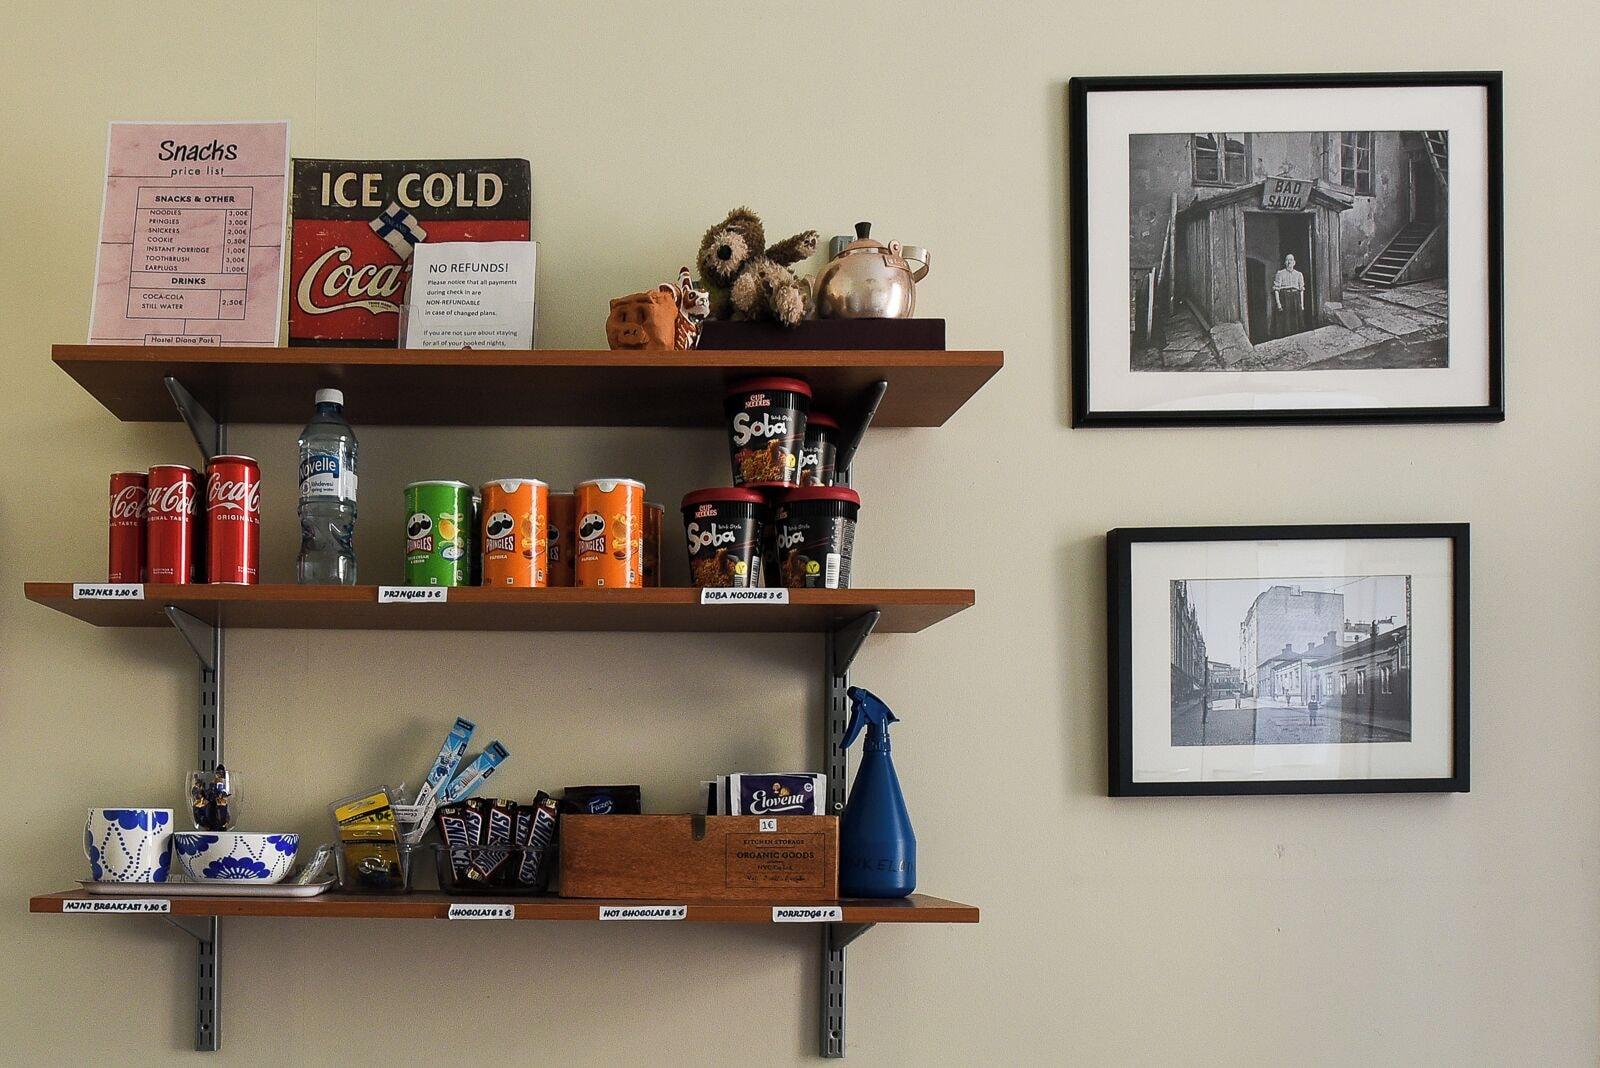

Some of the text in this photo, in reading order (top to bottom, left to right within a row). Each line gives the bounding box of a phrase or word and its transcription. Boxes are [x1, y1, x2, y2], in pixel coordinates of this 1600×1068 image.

[158, 139, 238, 162] Snacks
[171, 165, 225, 178] price list
[321, 172, 504, 208] ICE COLD
[1275, 180, 1302, 194] BAD
[155, 195, 235, 203] SNACKS & OTHER
[1267, 195, 1302, 209] SAUNA
[228, 210, 249, 218] 3,00€
[228, 219, 248, 227] 3,00€
[227, 229, 248, 237] 2,00€
[226, 238, 247, 246] 0,50€
[177, 246, 210, 254] PORRIDGE
[226, 248, 246, 256] 1,00€
[225, 257, 245, 265] 3,00€
[225, 266, 245, 274] 1,00€
[429, 263, 509, 274] NO REFUNDS!
[171, 277, 206, 285] DRINKS
[733, 412, 787, 447] Soba
[800, 450, 818, 468] ba
[687, 522, 736, 556] Soba
[485, 535, 514, 554] PRINGLES
[578, 537, 605, 556] PRINGLES
[79, 588, 113, 596] DRINKS
[132, 589, 138, 597] €
[384, 590, 426, 599] PRINGLES
[705, 591, 728, 599] SOBA
[730, 591, 768, 599] NOODLES
[776, 591, 783, 599] €
[589, 799, 613, 814] Fazer
[750, 790, 805, 815] Elovena
[762, 821, 774, 830] 1€
[736, 851, 815, 859] ORGANIC GOODS
[65, 902, 91, 910] MINI
[93, 902, 141, 911] BREAKFAST
[603, 909, 620, 917] HOT
[622, 909, 670, 917] CHOCOLATE
[777, 910, 821, 919] PORRIDGE
